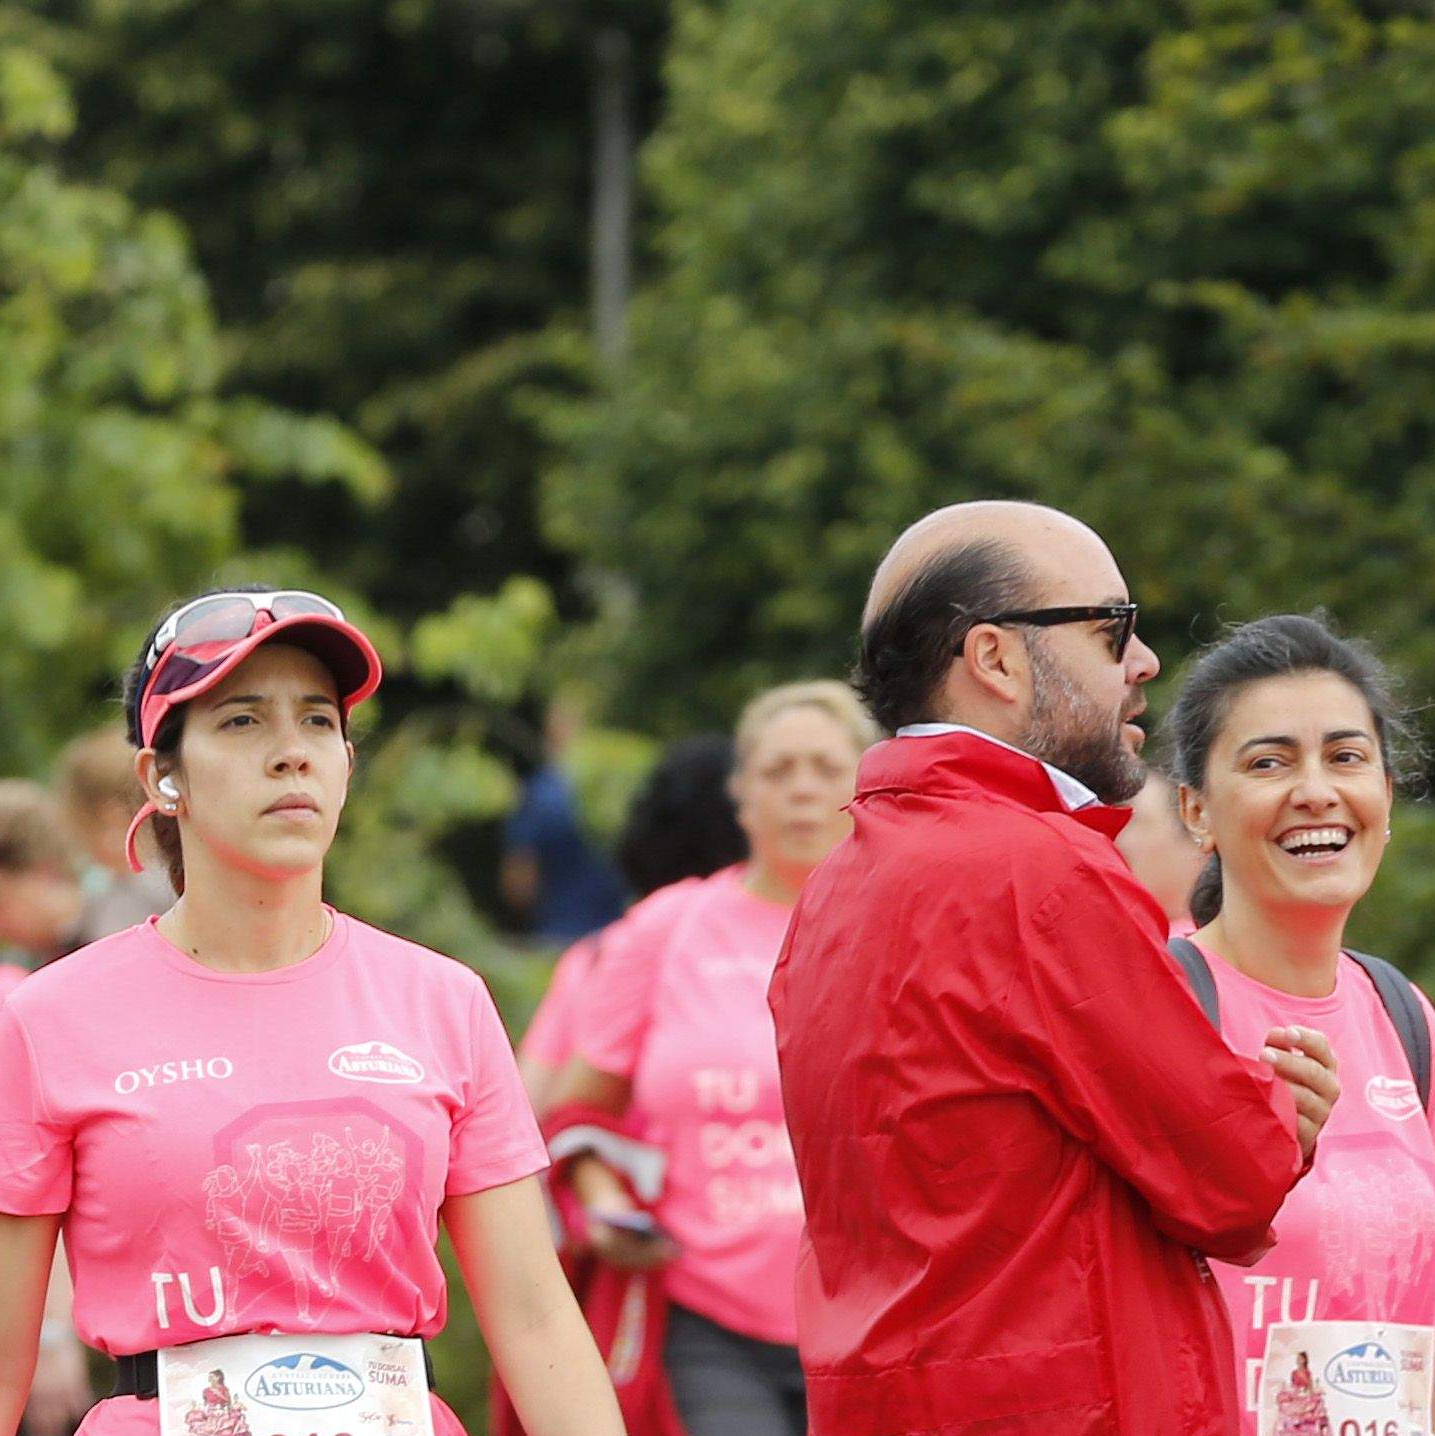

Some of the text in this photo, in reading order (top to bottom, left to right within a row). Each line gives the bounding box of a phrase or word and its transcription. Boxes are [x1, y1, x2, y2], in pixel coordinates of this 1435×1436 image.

[114, 1056, 233, 1095] OYSHO
[695, 1067, 759, 1114] TU
[151, 1265, 224, 1330] TU
[1243, 1275, 1319, 1330] TU
[255, 1375, 357, 1397] ASTURIANA
[368, 1371, 407, 1387] SUMA
